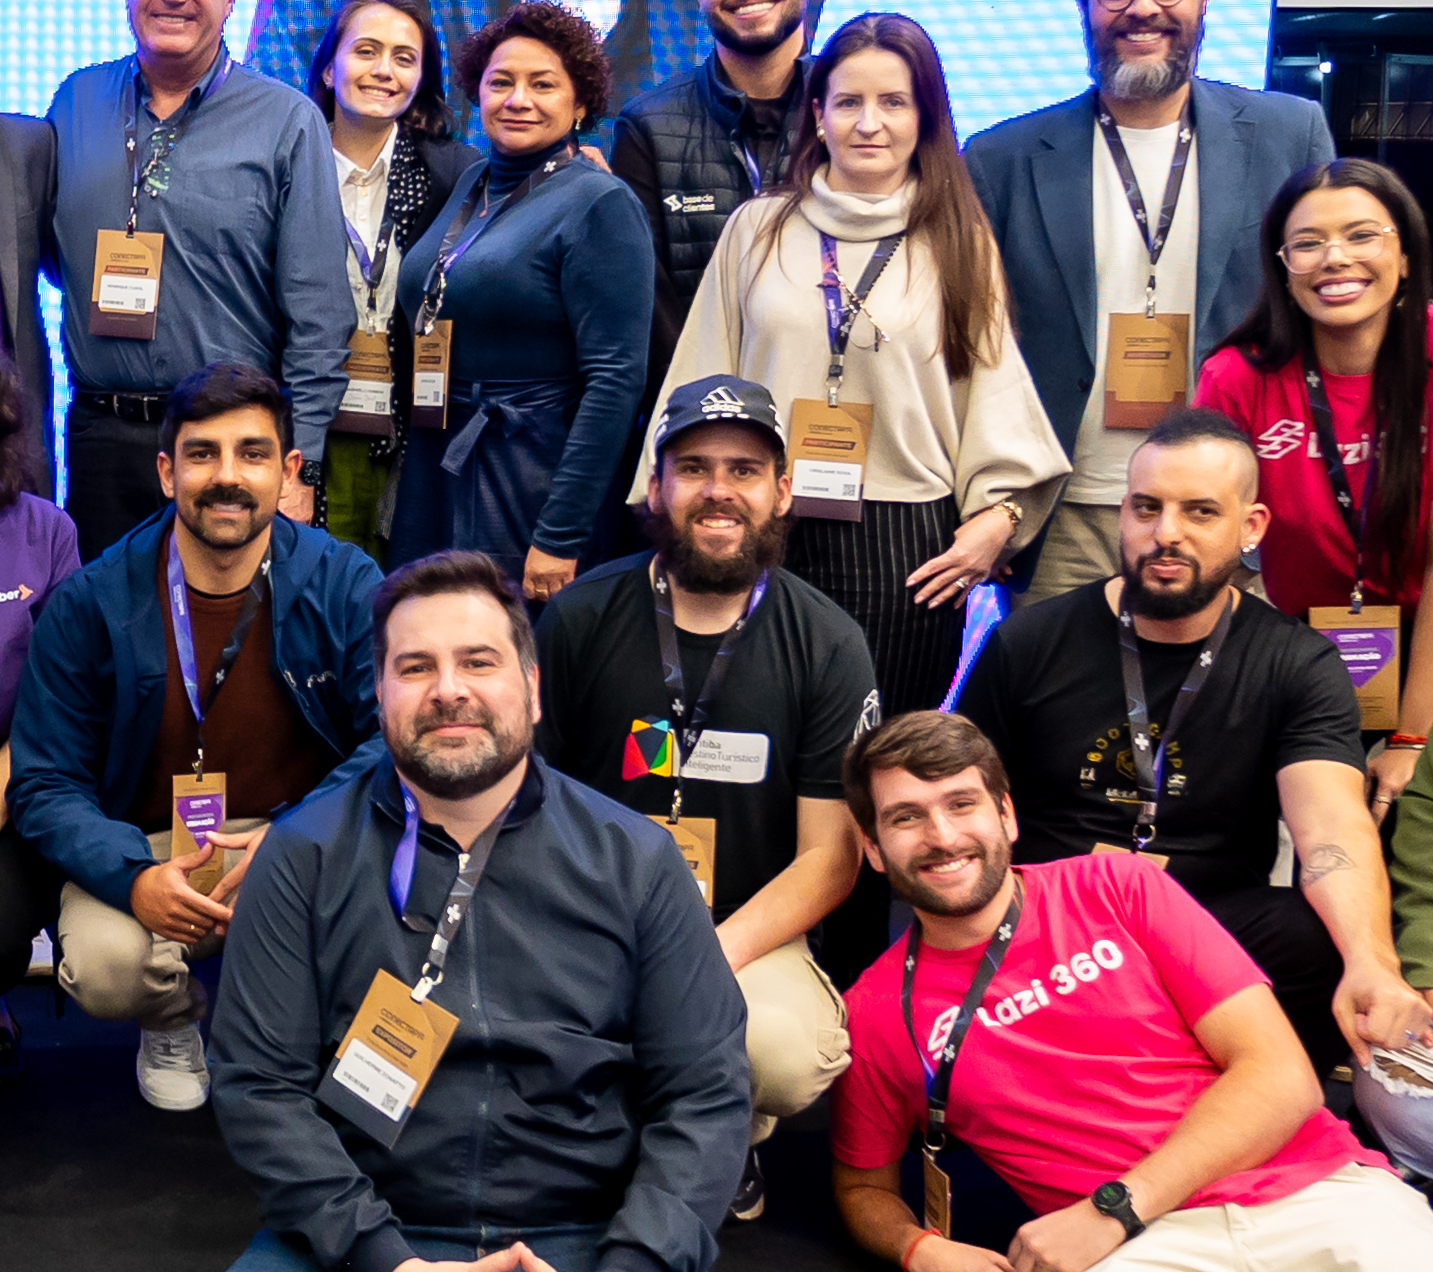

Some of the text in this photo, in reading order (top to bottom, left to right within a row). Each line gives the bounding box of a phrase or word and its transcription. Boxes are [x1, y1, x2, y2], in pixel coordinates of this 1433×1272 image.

[702, 404, 742, 413] adidas
[1307, 432, 1370, 465] Lzi
[688, 760, 732, 773] teligente
[975, 939, 1124, 1027] Lazi 360
